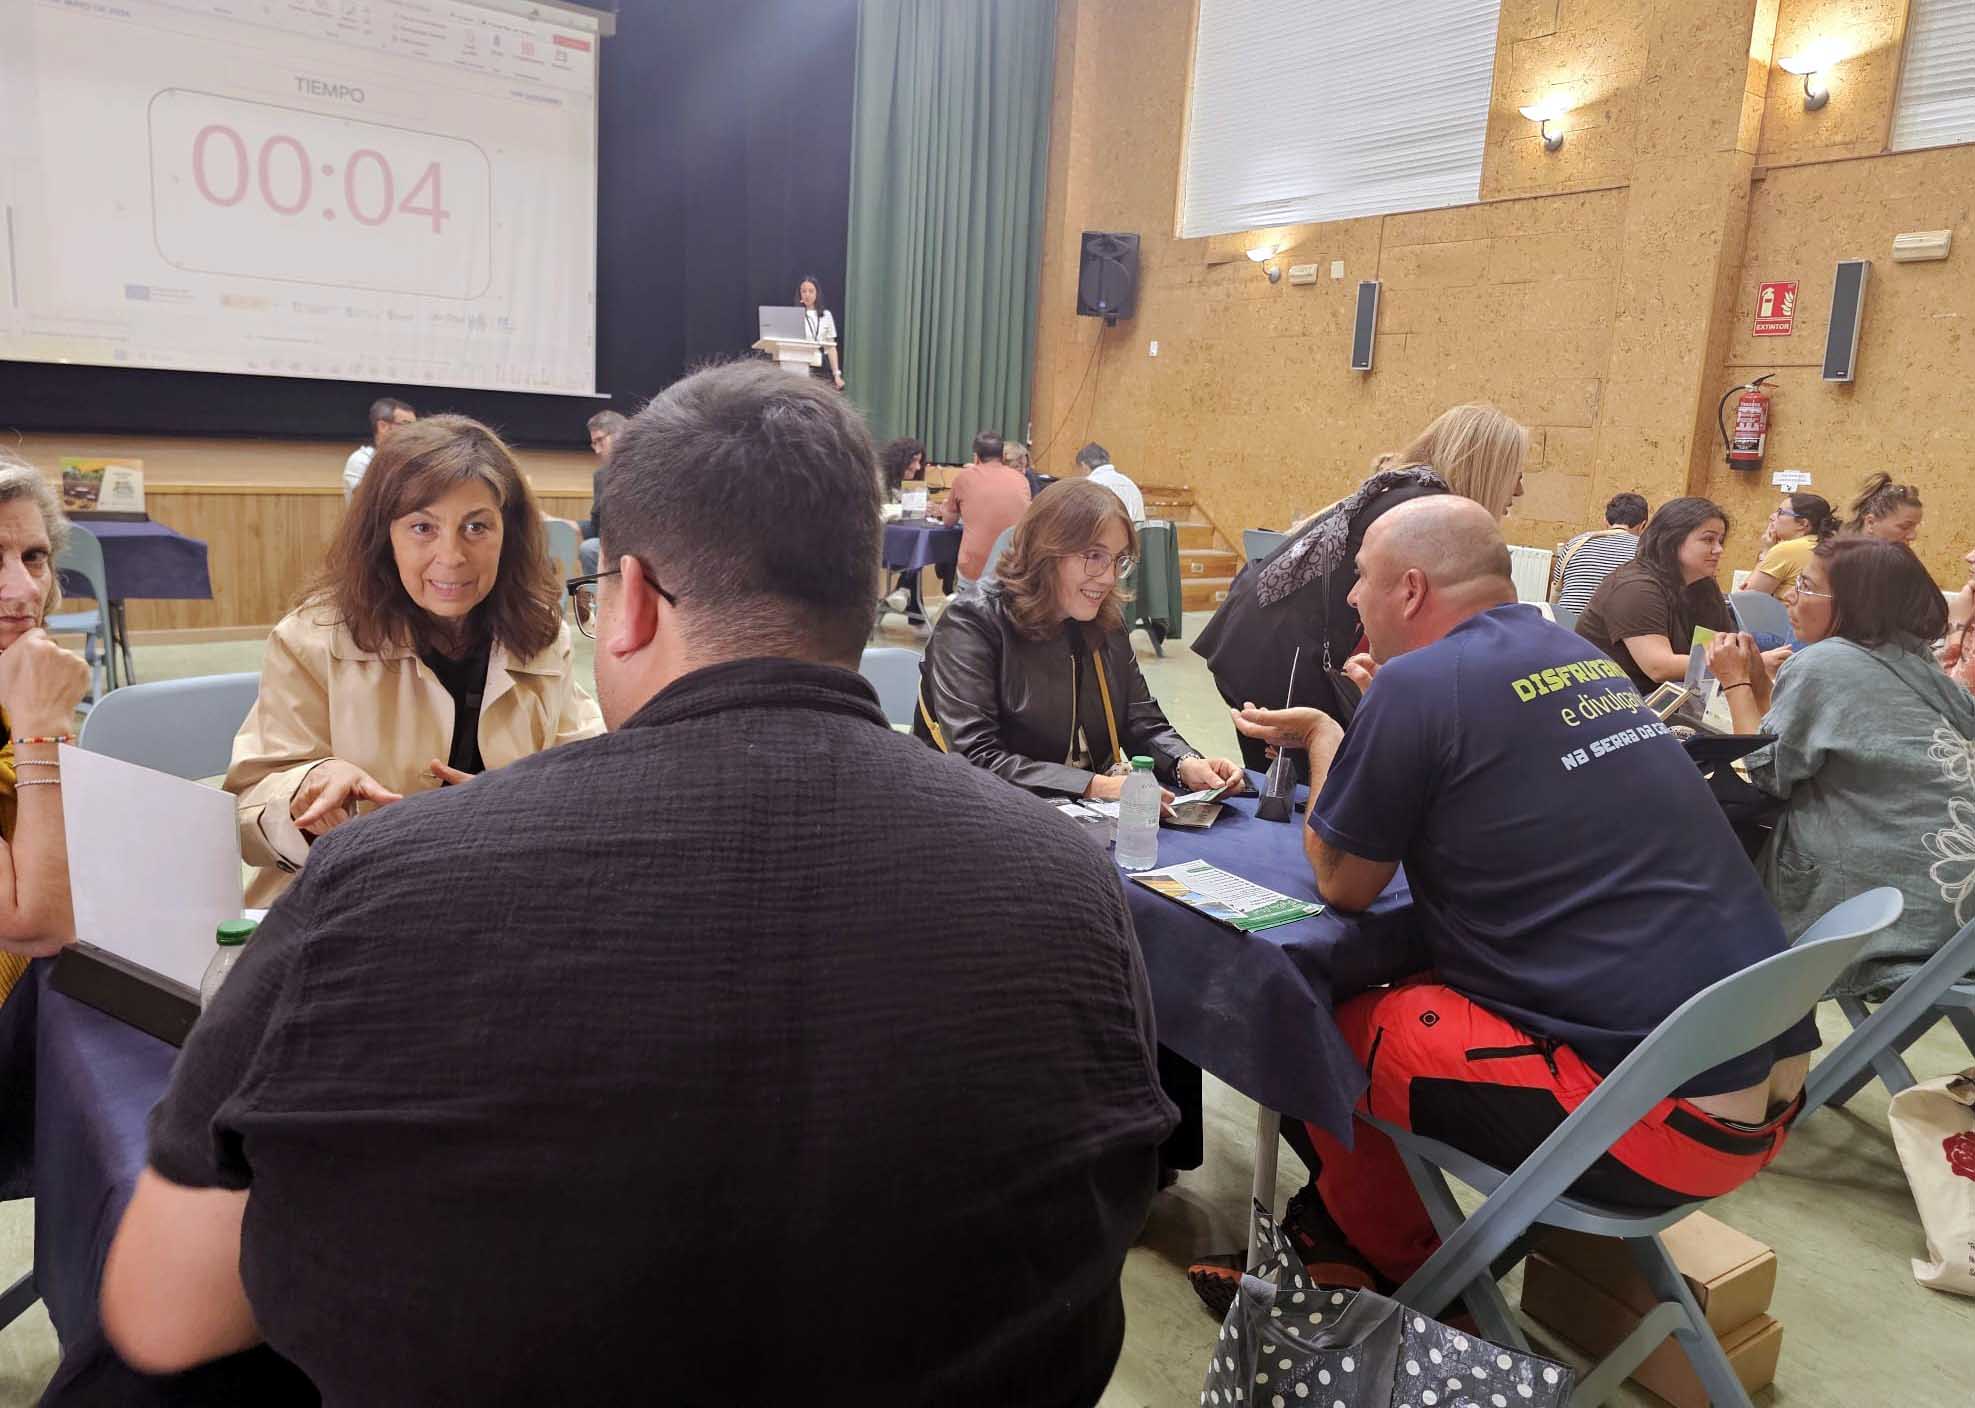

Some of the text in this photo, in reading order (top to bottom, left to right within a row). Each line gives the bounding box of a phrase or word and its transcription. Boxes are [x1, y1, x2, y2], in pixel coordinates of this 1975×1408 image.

[295, 76, 366, 104] TIEMPO
[192, 123, 451, 234] 00:04
[1756, 323, 1790, 331] EXTINTOR
[1561, 708, 1580, 726] e
